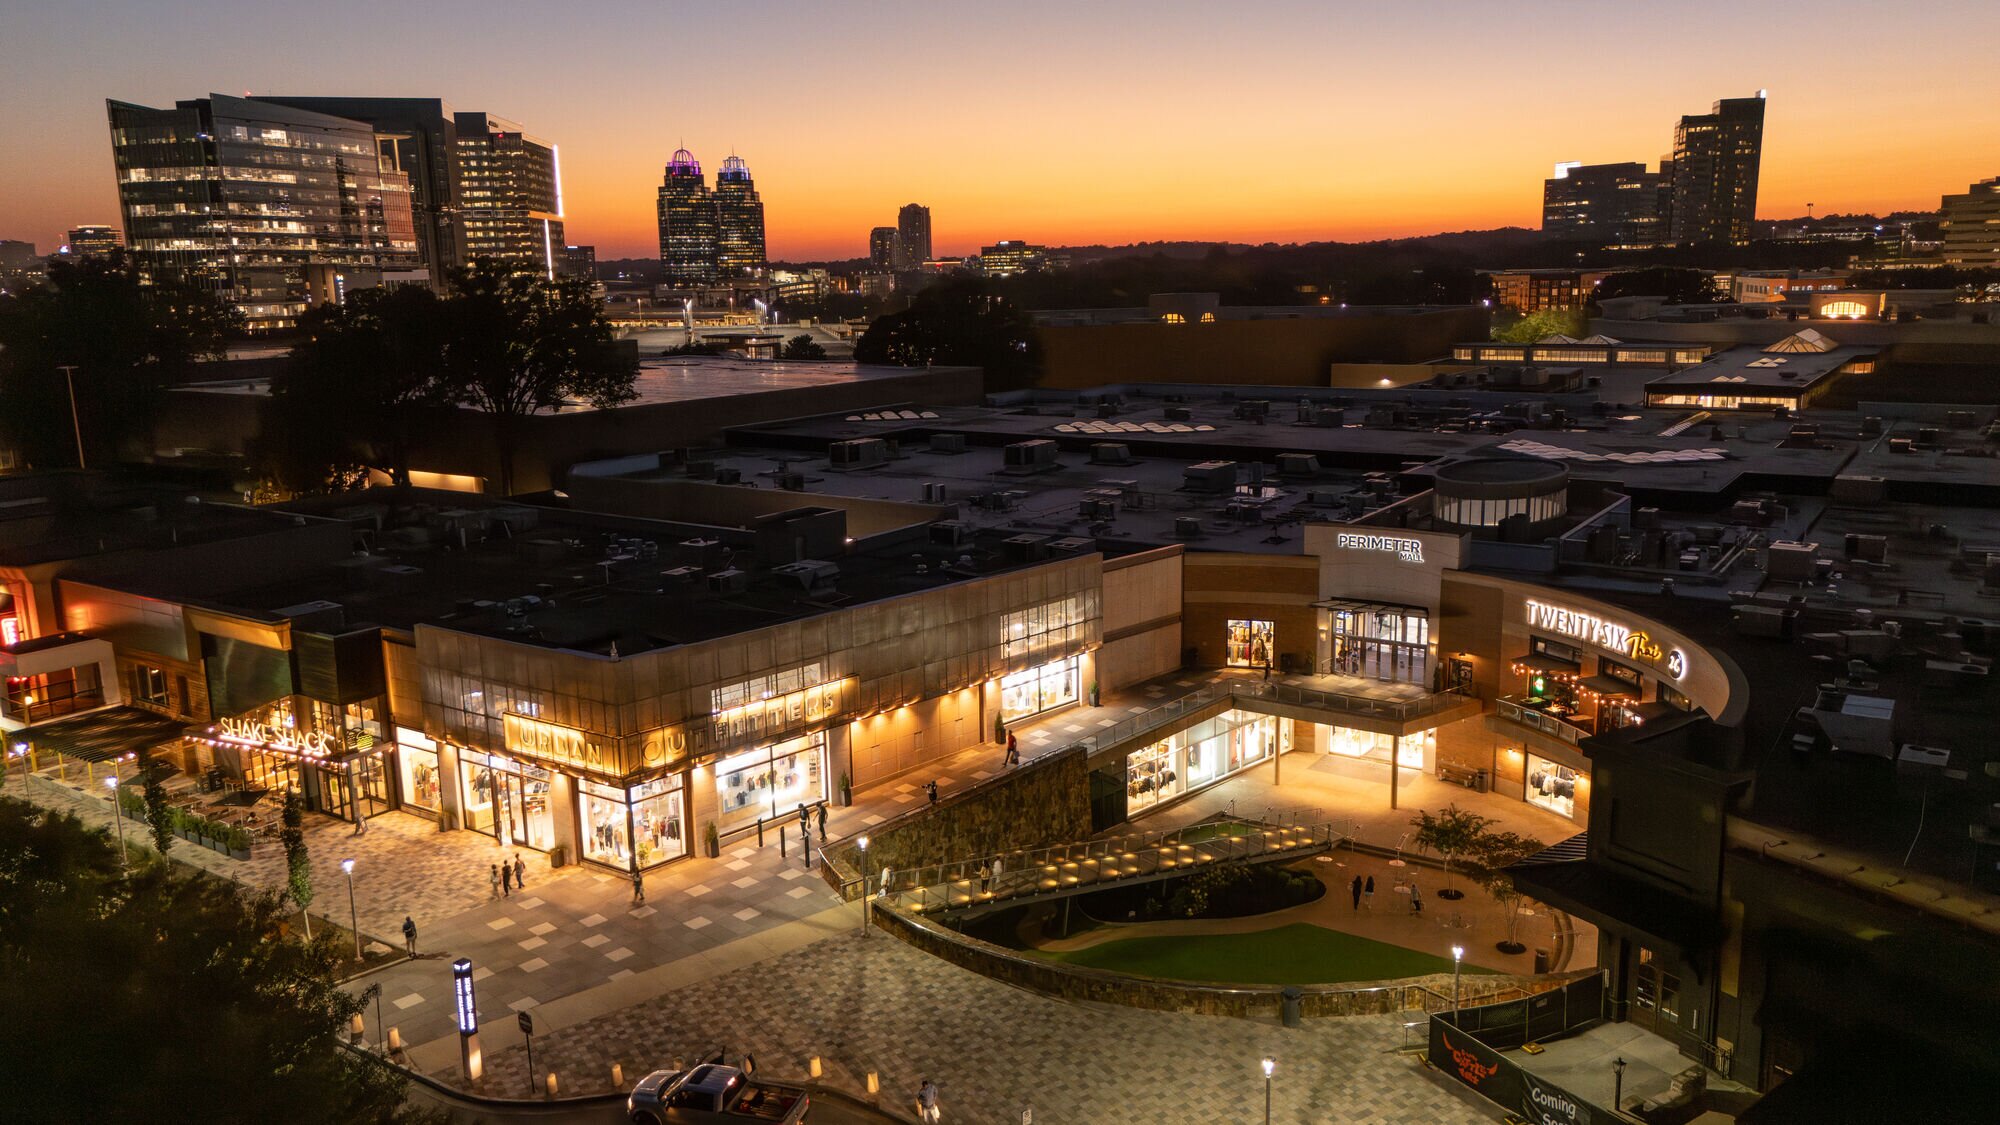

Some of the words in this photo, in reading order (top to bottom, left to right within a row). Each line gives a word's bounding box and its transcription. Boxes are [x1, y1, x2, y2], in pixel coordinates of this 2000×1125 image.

[1338, 533, 1421, 553] PERIMETER
[1399, 551, 1424, 562] MALL
[1625, 632, 1660, 658] Thai
[220, 716, 272, 744] SHAKE
[272, 726, 332, 756] SHACK
[1532, 1087, 1576, 1120] Coming
[1542, 1113, 1569, 1125] So
